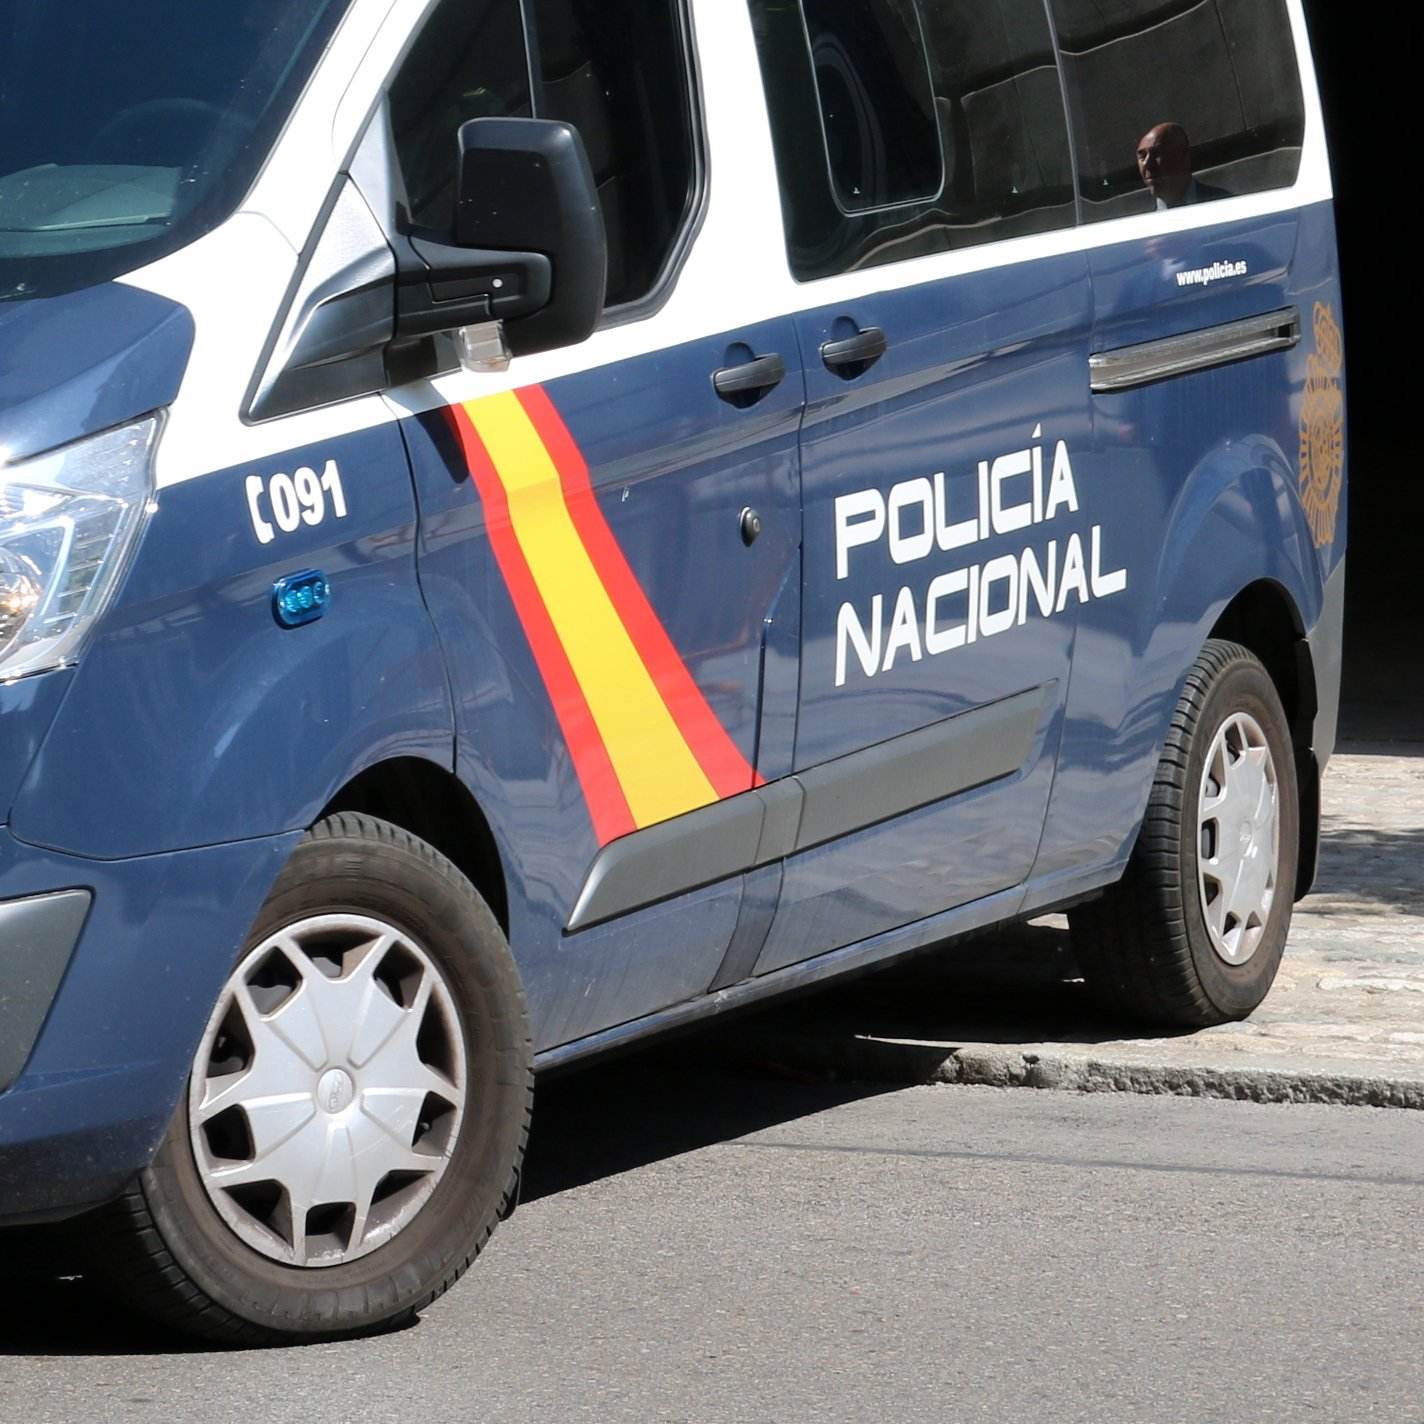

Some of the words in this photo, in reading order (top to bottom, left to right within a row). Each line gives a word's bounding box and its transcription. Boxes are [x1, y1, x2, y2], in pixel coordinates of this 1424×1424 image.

[1176, 260, 1247, 286] www.policia.es
[269, 459, 347, 532] 091
[835, 423, 1079, 580] POLICÍA
[835, 525, 1127, 687] NACIONAL
